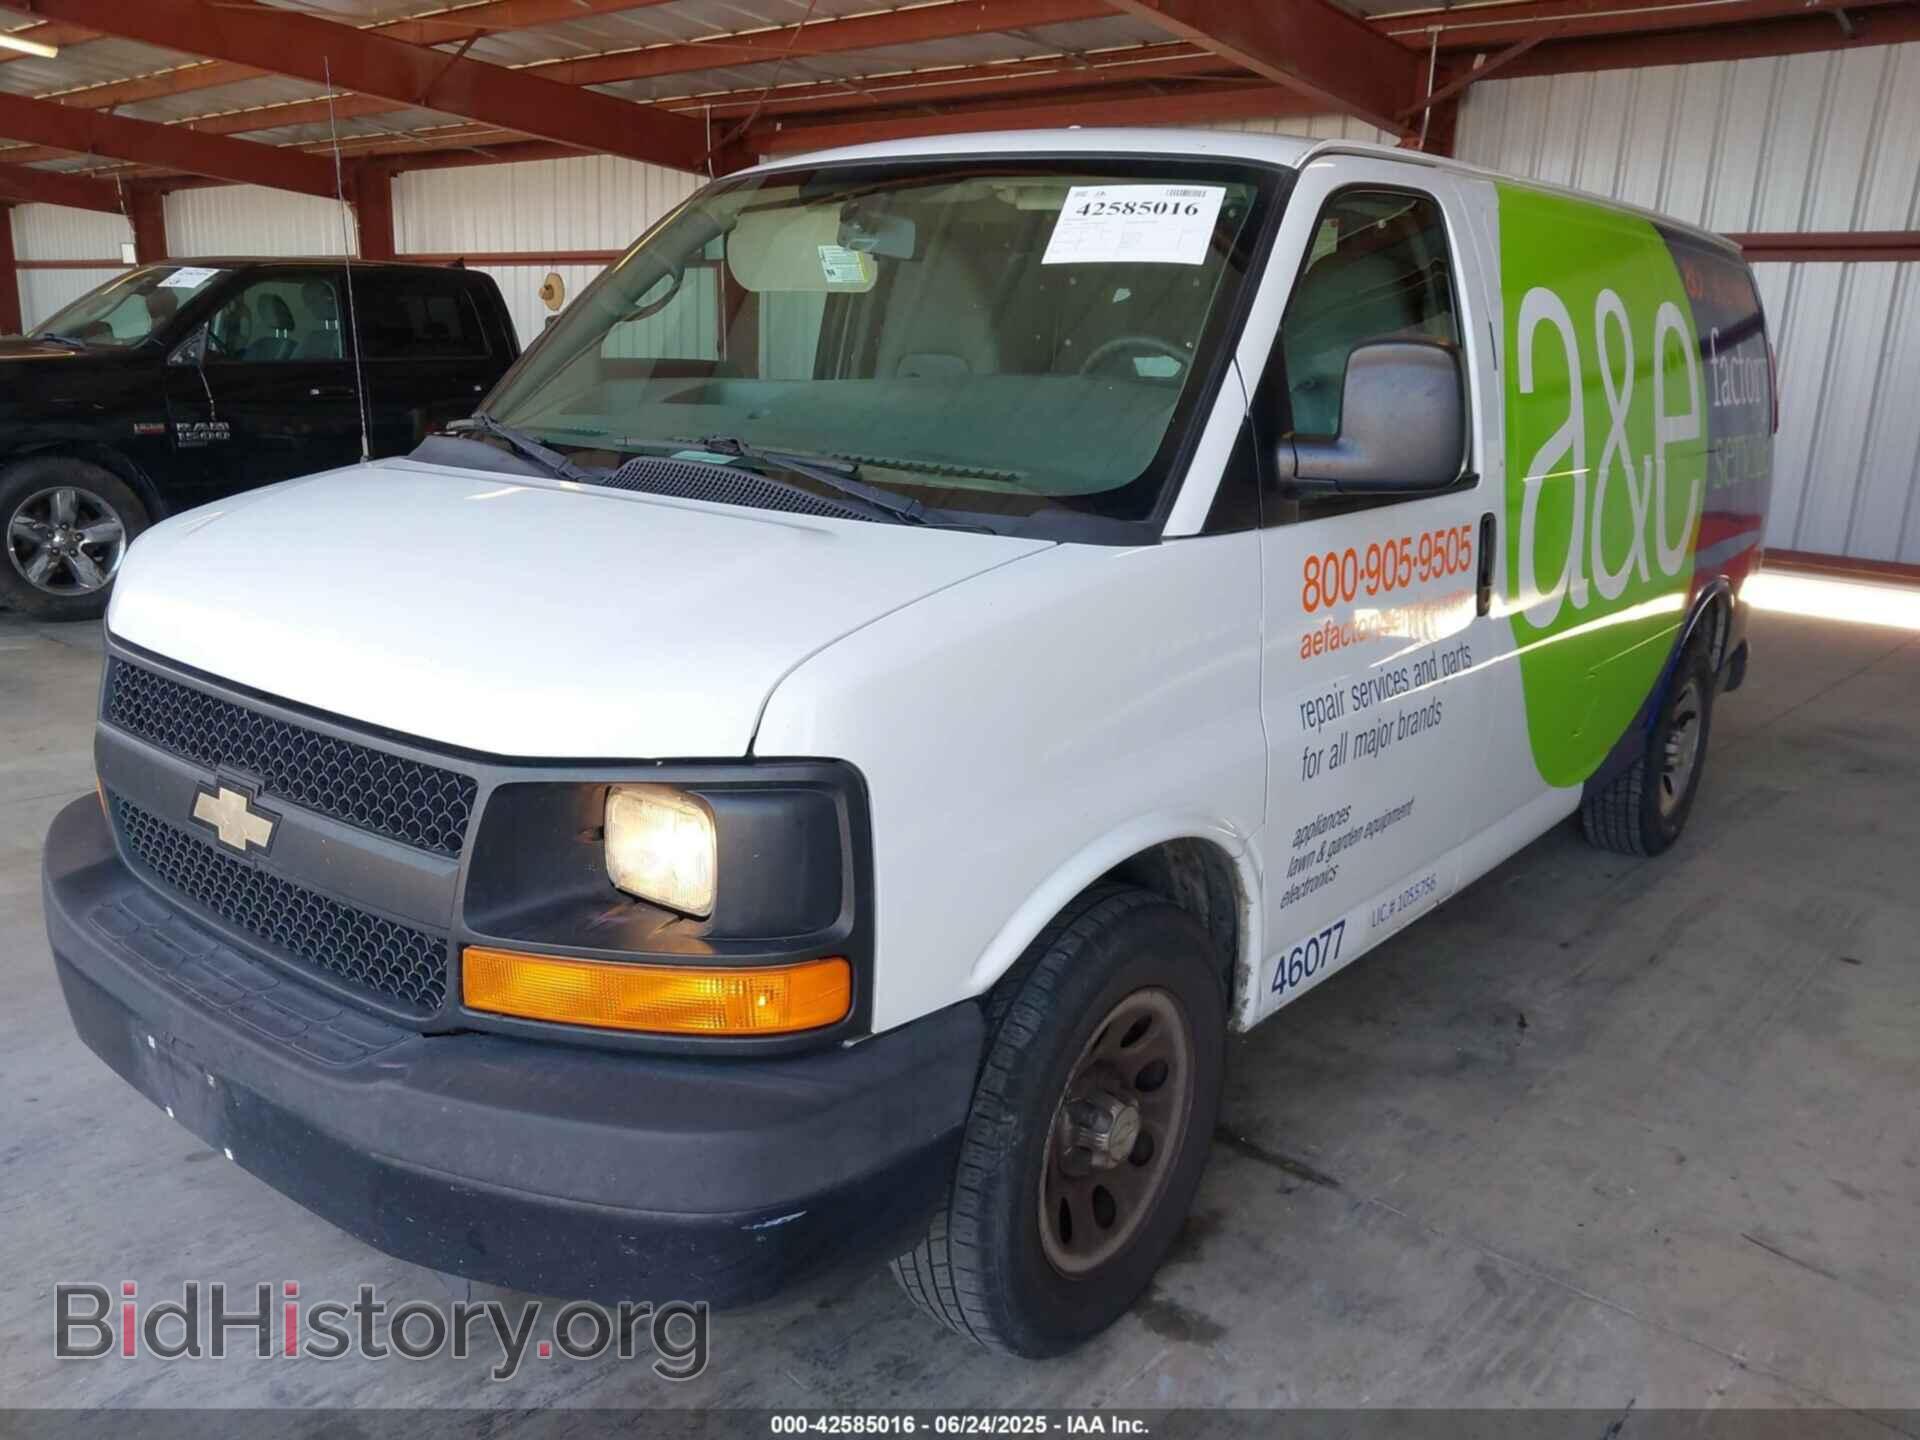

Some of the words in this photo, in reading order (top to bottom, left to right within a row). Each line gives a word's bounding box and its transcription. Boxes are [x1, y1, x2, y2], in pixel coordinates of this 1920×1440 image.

[1075, 201, 1200, 216] 42585016
[1517, 286, 1700, 629] a&e
[1300, 682, 1345, 733] repair
[1351, 667, 1410, 711] services
[1414, 650, 1438, 687] and
[1441, 641, 1473, 684] parts
[1302, 746, 1324, 782] for
[1328, 731, 1349, 770] all
[1353, 717, 1395, 758] major
[1397, 696, 1443, 741] brands
[1286, 849, 1316, 878] lawn
[1315, 840, 1327, 864] &
[1325, 825, 1364, 863] garden
[1363, 796, 1415, 840] equipment
[1292, 804, 1351, 849] appliances
[1280, 864, 1339, 910] electronics
[1271, 919, 1346, 995] 46077
